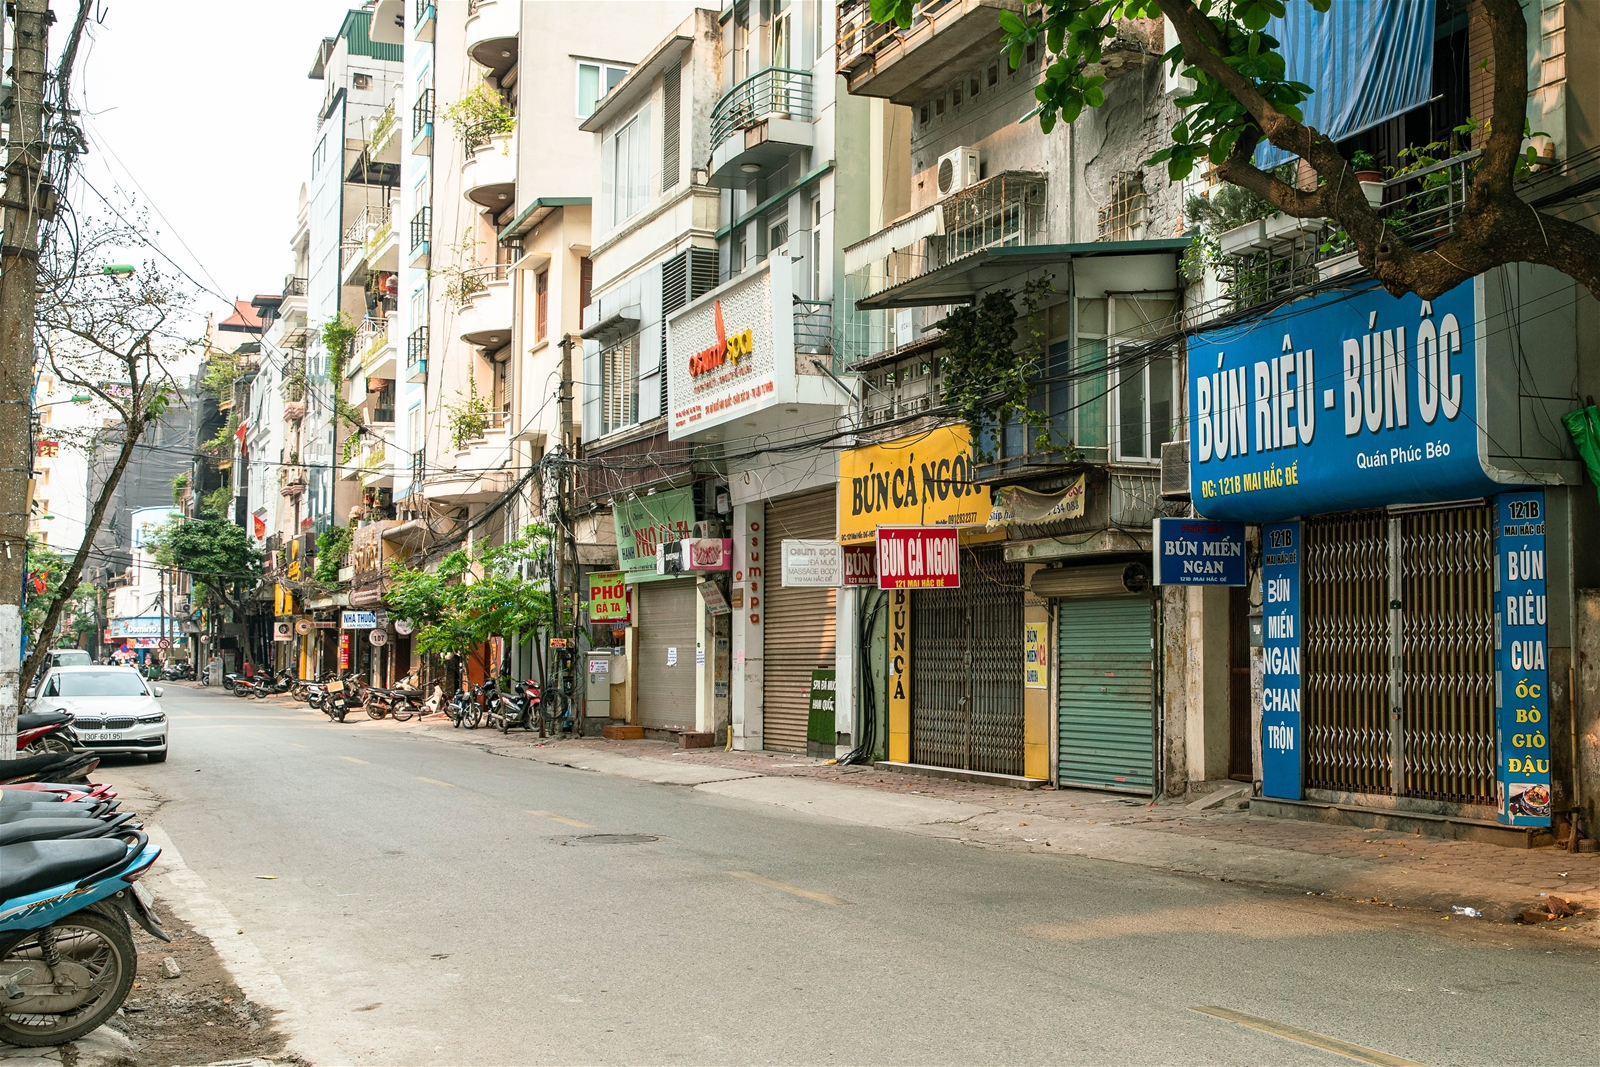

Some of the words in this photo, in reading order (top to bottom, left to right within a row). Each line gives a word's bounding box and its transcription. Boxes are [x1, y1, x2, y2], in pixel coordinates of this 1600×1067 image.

[726, 327, 753, 367] spa
[1197, 353, 1247, 462] BÚN
[1254, 333, 1315, 452] RIÊU
[1323, 388, 1335, 408] -
[1343, 310, 1408, 435] BÚN
[1356, 450, 1388, 470] Quán
[1390, 445, 1423, 465] Phúc
[1425, 441, 1451, 459] Béo
[852, 462, 890, 516] BÚN
[892, 452, 918, 509] CÁ
[921, 453, 981, 504] NGON
[1219, 473, 1241, 495] 121B
[1243, 471, 1262, 491] MAI
[1264, 464, 1284, 488] HẮC
[1285, 460, 1299, 486] ĐẾ
[1508, 501, 1540, 519] 121B
[1269, 529, 1292, 549] 121B
[1504, 526, 1518, 536] MAI
[1519, 523, 1535, 536] HẮC
[818, 548, 837, 557] spa
[881, 532, 905, 577] BÚN
[907, 532, 924, 576] CÁ
[926, 537, 957, 575] NGON
[1164, 537, 1198, 556] BÚN
[1202, 536, 1241, 557] MIẾN
[845, 549, 870, 575] BÚN
[1183, 561, 1224, 574] NGAN
[1265, 554, 1276, 565] MAI
[1507, 544, 1544, 580] BÚN
[591, 580, 624, 600] PHỞ
[895, 580, 906, 588] 121
[907, 579, 920, 588] MAI
[1267, 574, 1290, 603] BÚN
[596, 602, 608, 613] GÀ
[610, 602, 621, 612] TA
[1506, 589, 1547, 626] RIÊU
[1268, 608, 1294, 639] MIẾN
[1263, 647, 1300, 675] NGAN
[1511, 640, 1545, 671] CUA
[1263, 688, 1300, 712] CHAN
[1515, 678, 1541, 699] ỐC
[1515, 706, 1541, 724] BÒ
[1268, 721, 1294, 754] TRỘN
[1511, 729, 1546, 749] GIÒ
[1508, 755, 1550, 777] ĐẬU
